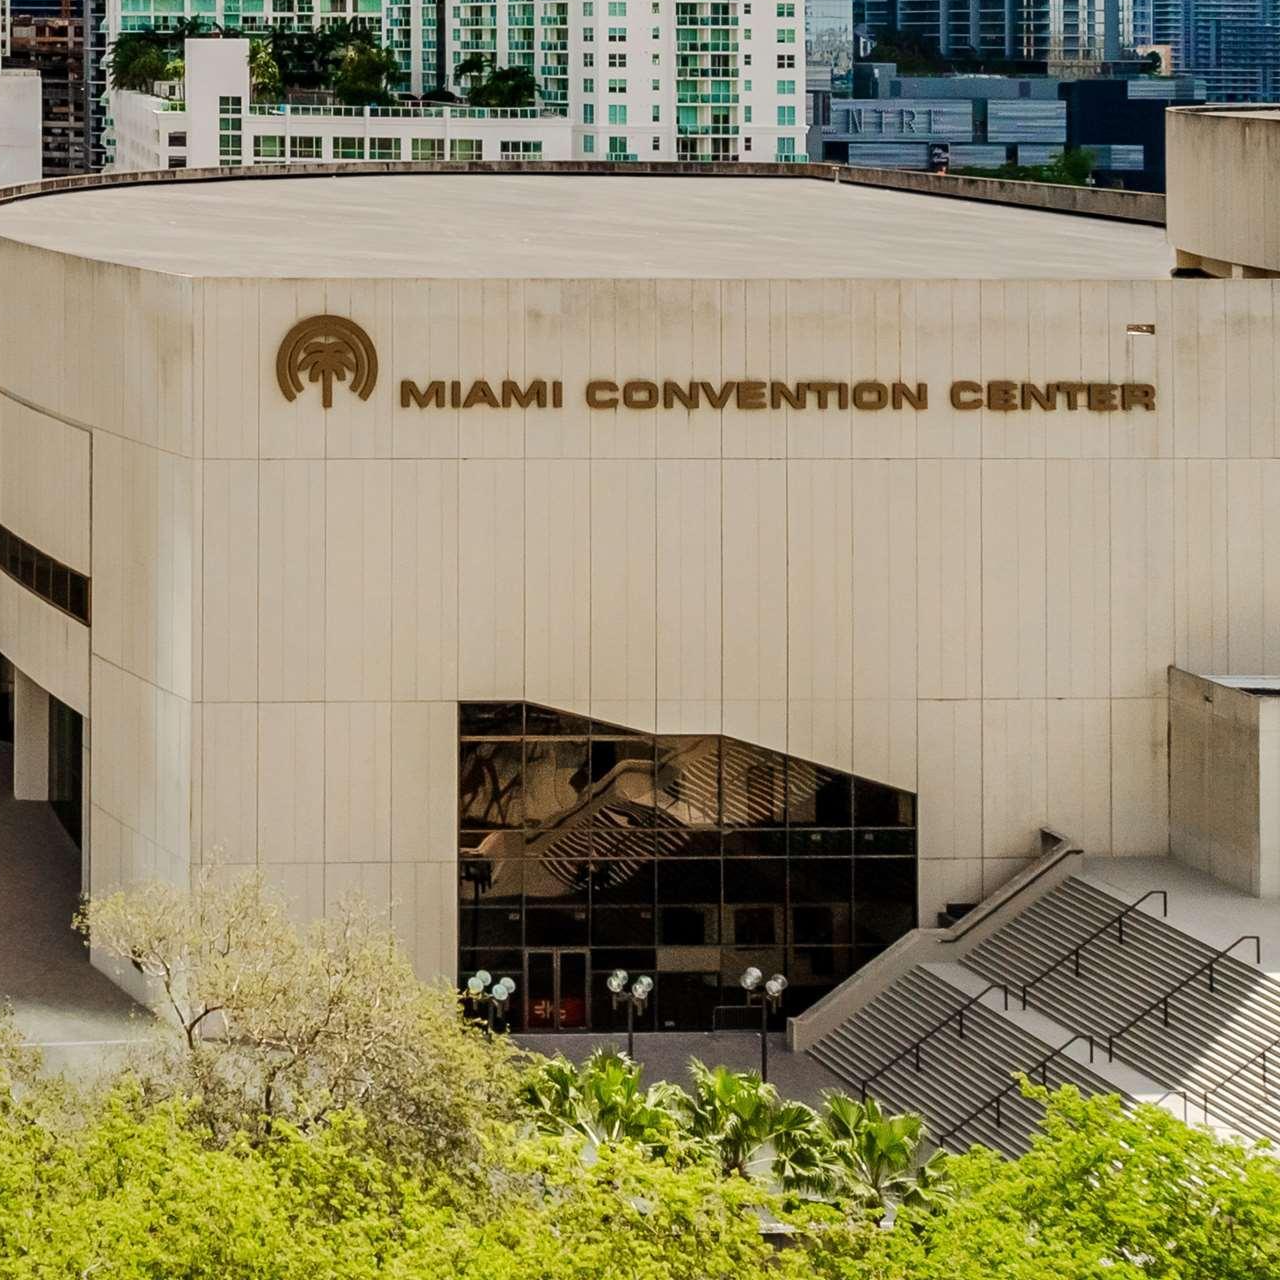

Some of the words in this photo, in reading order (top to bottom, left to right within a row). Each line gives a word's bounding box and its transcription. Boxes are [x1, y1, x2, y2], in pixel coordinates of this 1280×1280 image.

[399, 379, 563, 409] MIAMI
[584, 380, 929, 410] CONVENTION
[949, 380, 1156, 411] CENTER
